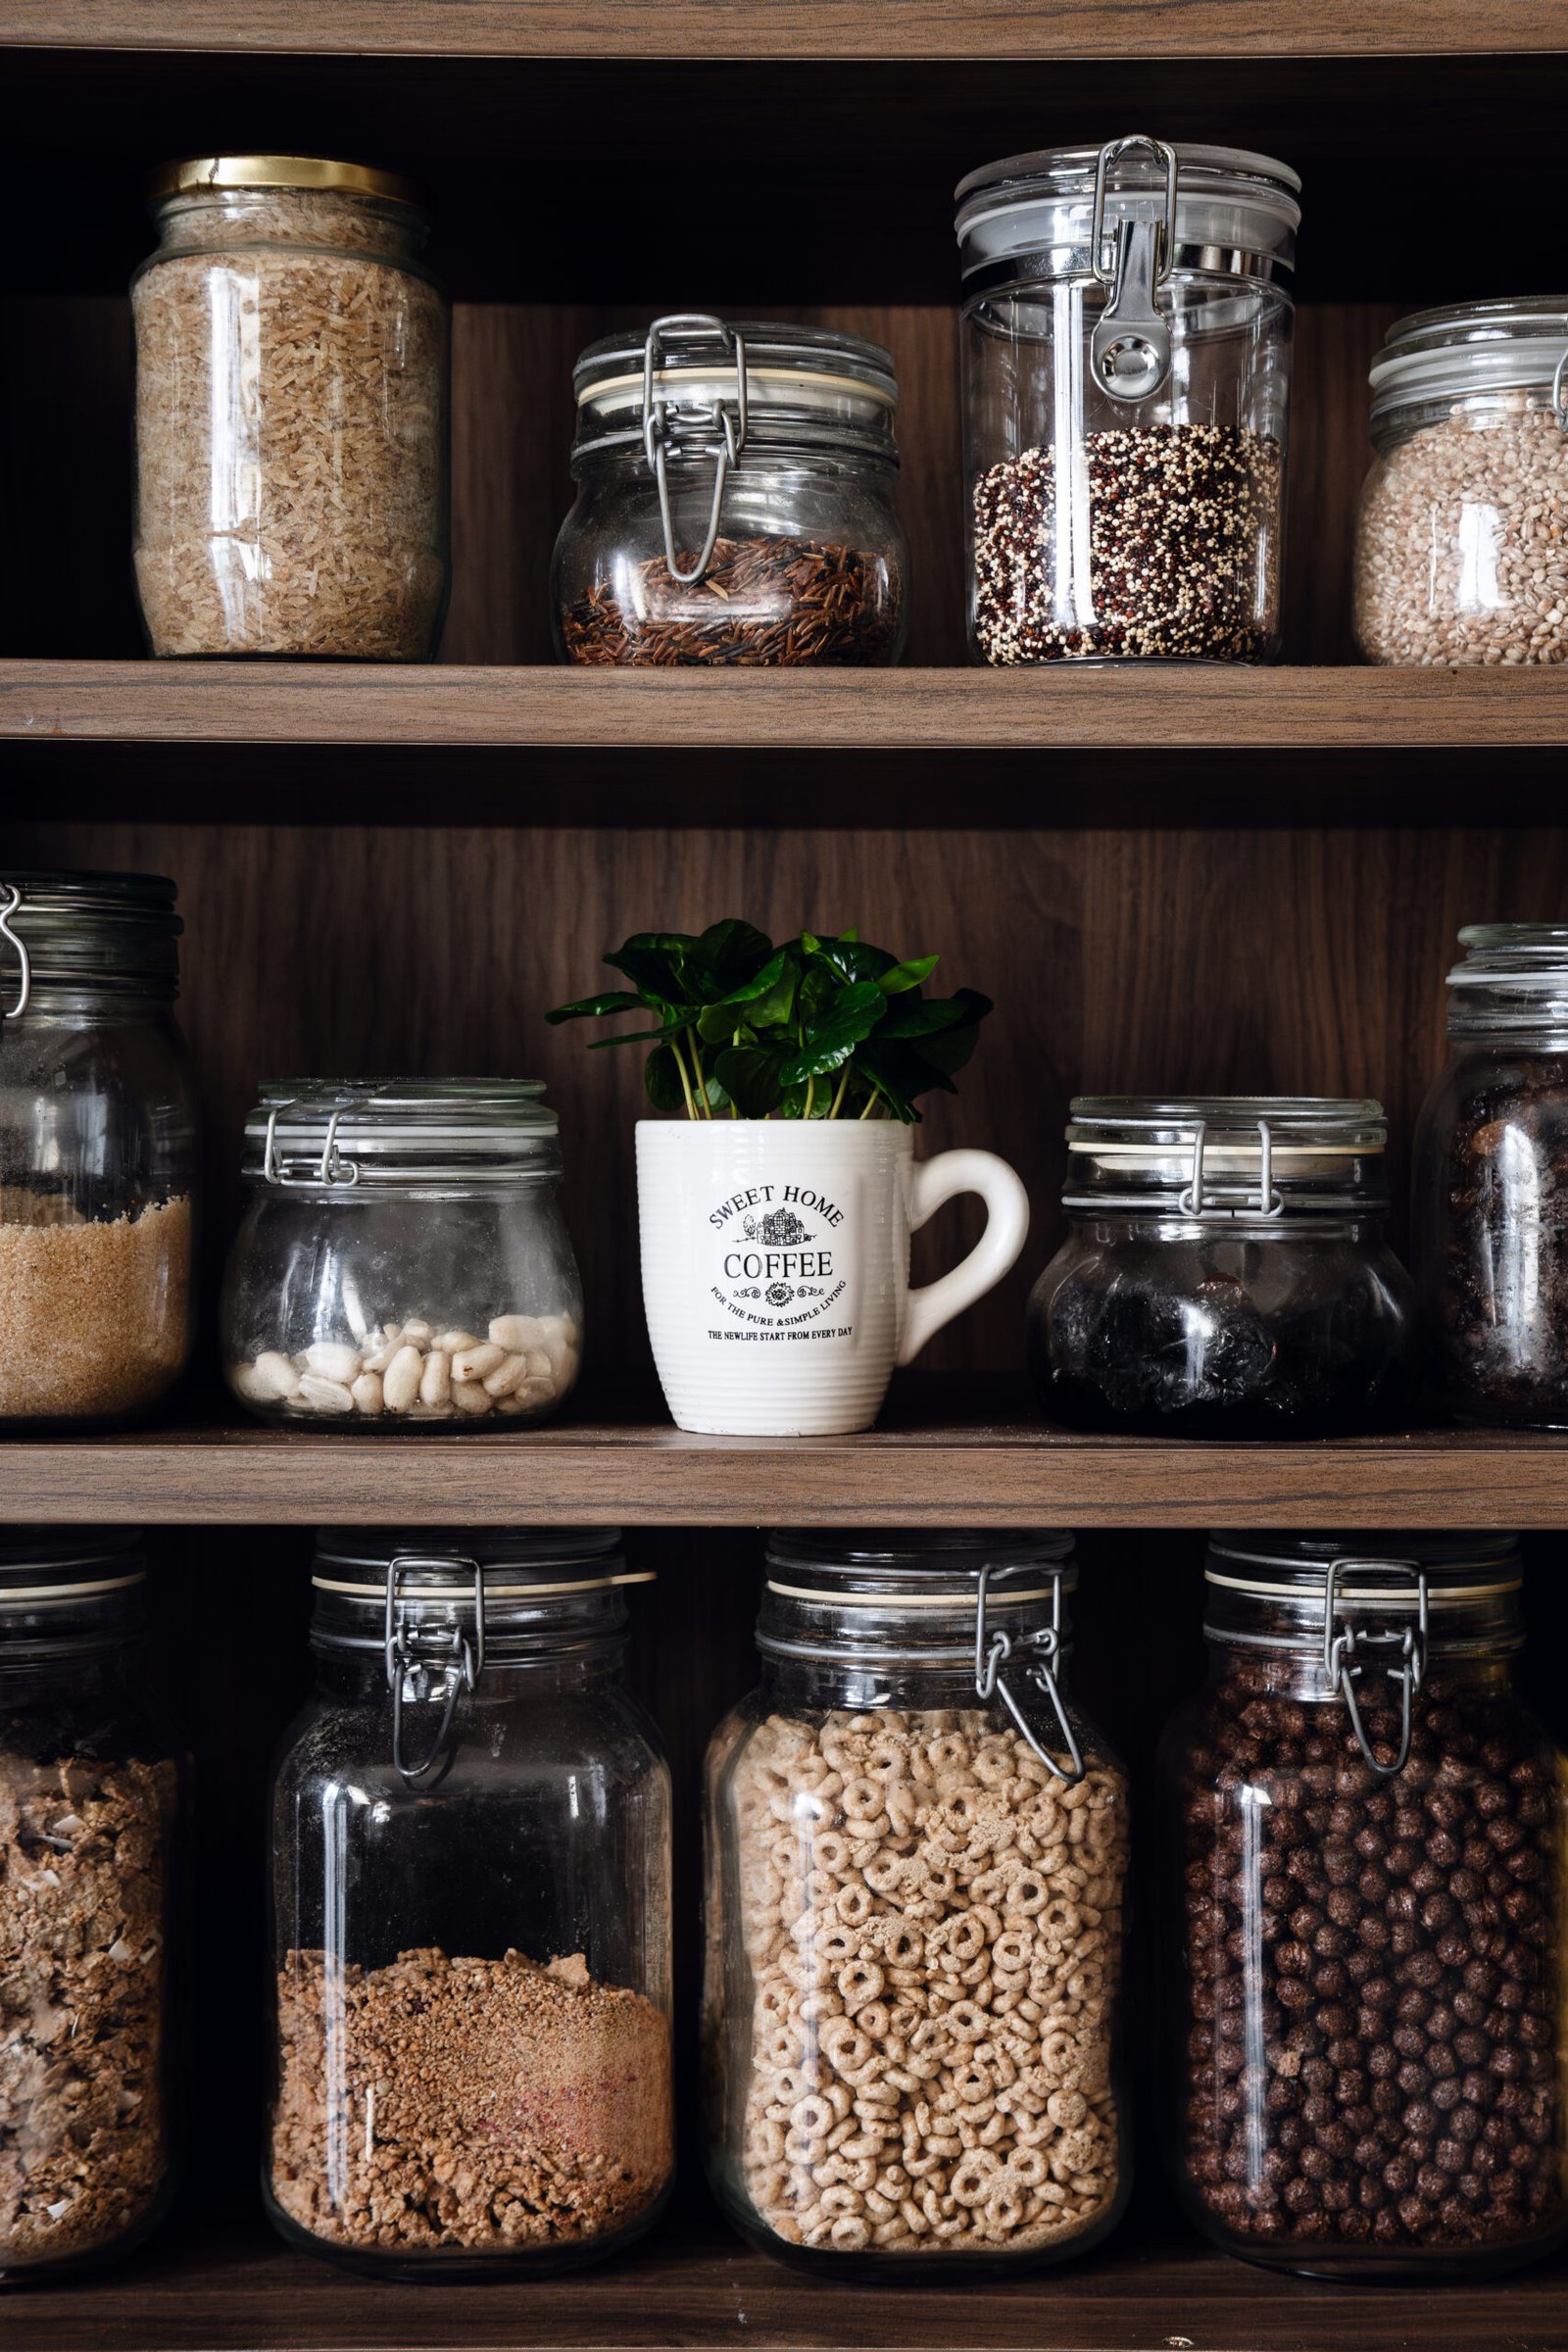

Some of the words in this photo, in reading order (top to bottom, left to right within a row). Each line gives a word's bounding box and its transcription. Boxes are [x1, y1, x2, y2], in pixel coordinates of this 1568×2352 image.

[709, 1185, 775, 1230] SWEET
[783, 1185, 845, 1228] HOME
[723, 1251, 834, 1279] COFFEE
[710, 1286, 727, 1305] FOR
[727, 1301, 746, 1319] THE
[747, 1313, 773, 1327] PURE
[820, 1279, 847, 1311] LIVING
[708, 1330, 722, 1340] THE
[760, 1331, 785, 1342] START
[787, 1330, 809, 1341] FROM
[811, 1328, 836, 1340] EVERY
[838, 1326, 853, 1337] DAY
